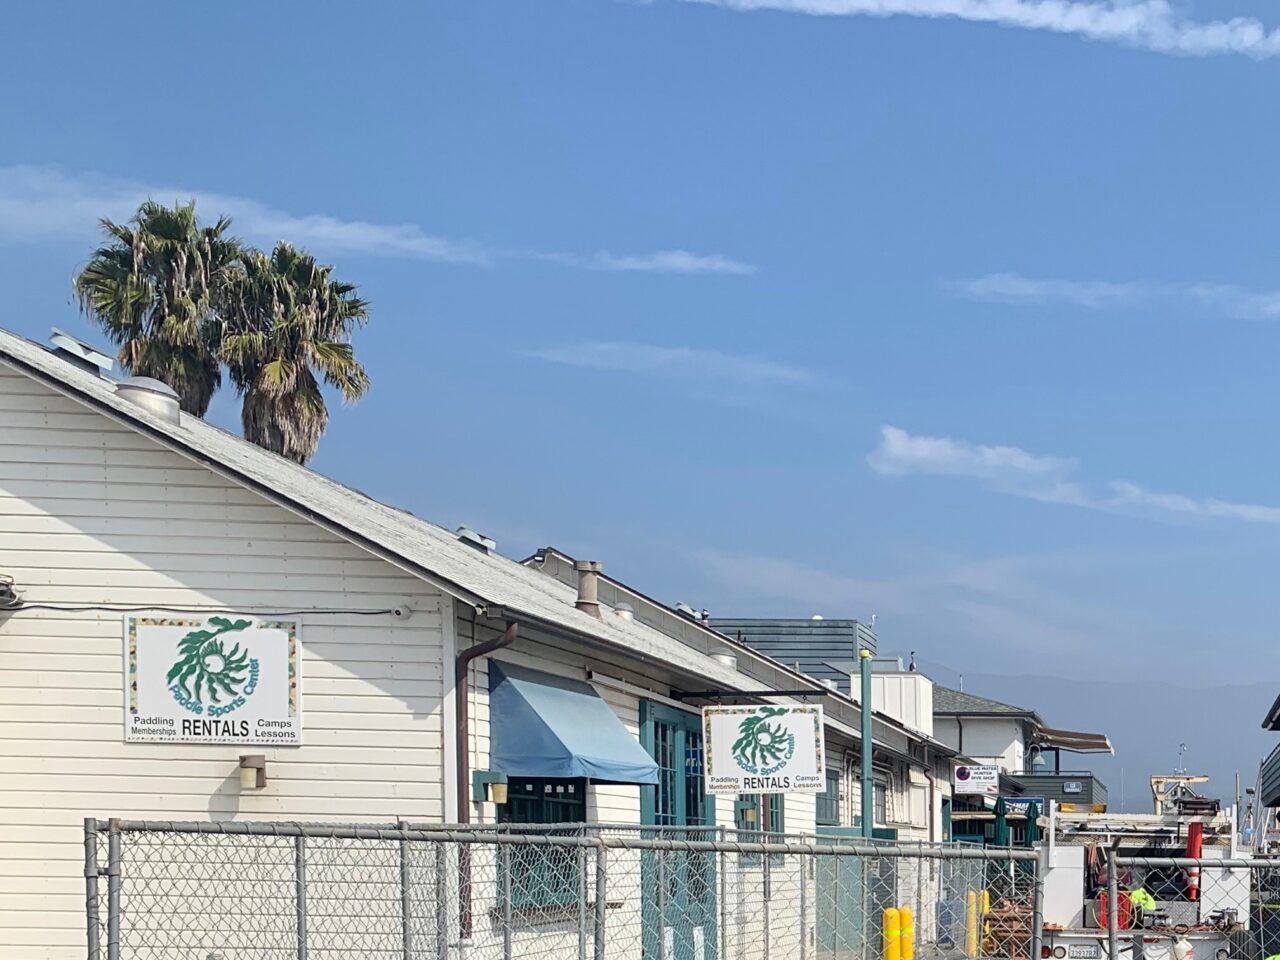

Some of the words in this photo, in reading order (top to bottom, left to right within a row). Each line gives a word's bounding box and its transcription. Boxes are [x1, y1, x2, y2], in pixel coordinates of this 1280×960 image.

[169, 684, 203, 714] Paddle
[207, 696, 246, 718] Sports
[243, 658, 259, 695] Center
[134, 716, 174, 727] Paddling
[257, 719, 292, 728] Camps
[131, 727, 176, 736] Memberships
[182, 719, 249, 737] RENTALS
[255, 729, 296, 738] Lessons
[733, 754, 758, 774] Paddle
[760, 760, 787, 776] Sports
[743, 776, 790, 789] RENTALS
